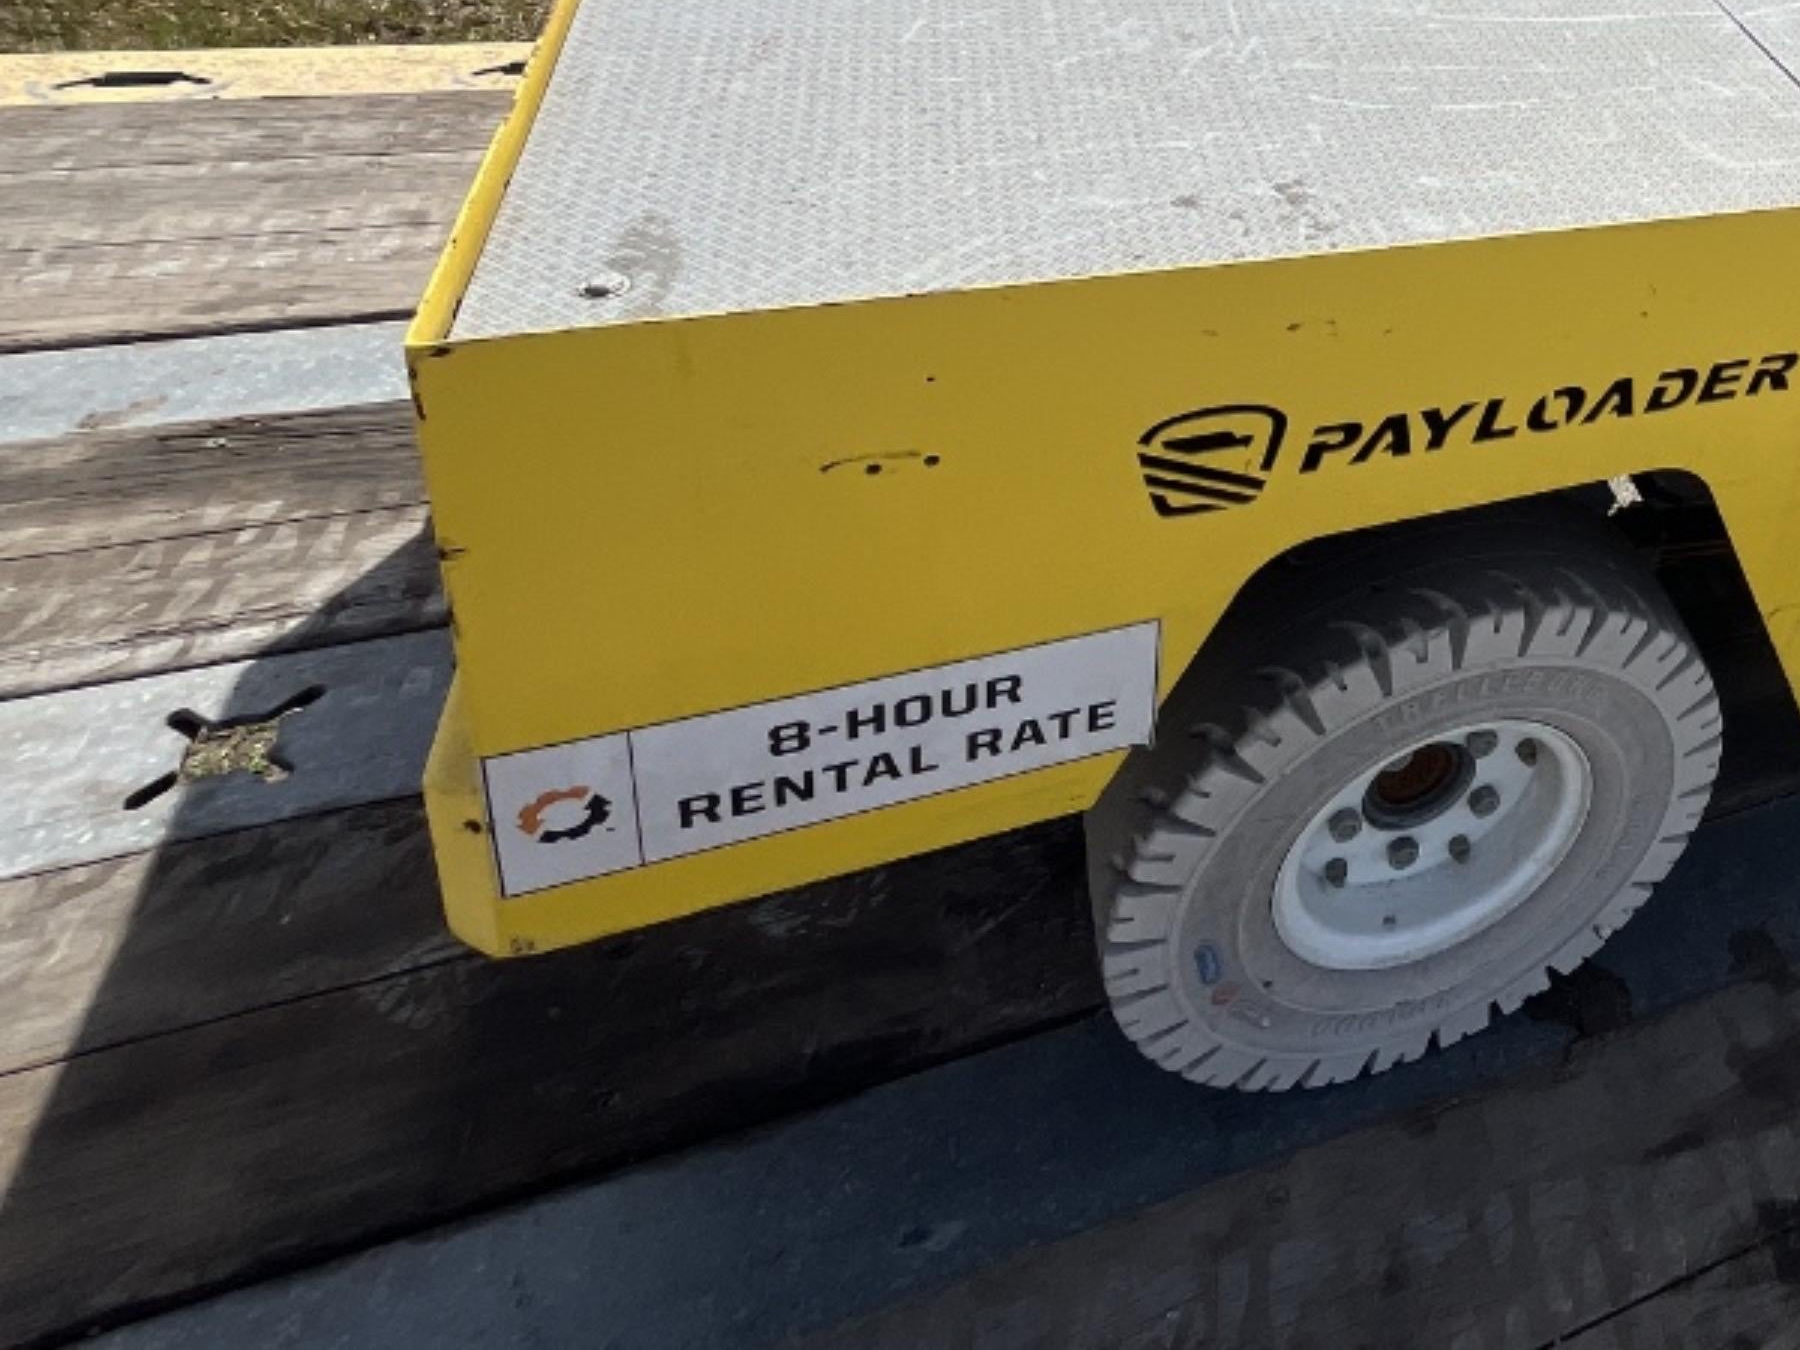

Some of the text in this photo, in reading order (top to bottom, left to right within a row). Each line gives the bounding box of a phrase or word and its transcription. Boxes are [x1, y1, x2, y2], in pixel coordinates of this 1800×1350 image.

[1299, 352, 1800, 475] PAYLOADER
[677, 700, 1118, 831] RENTAL RATE
[767, 672, 1022, 757] 8-HOUR
